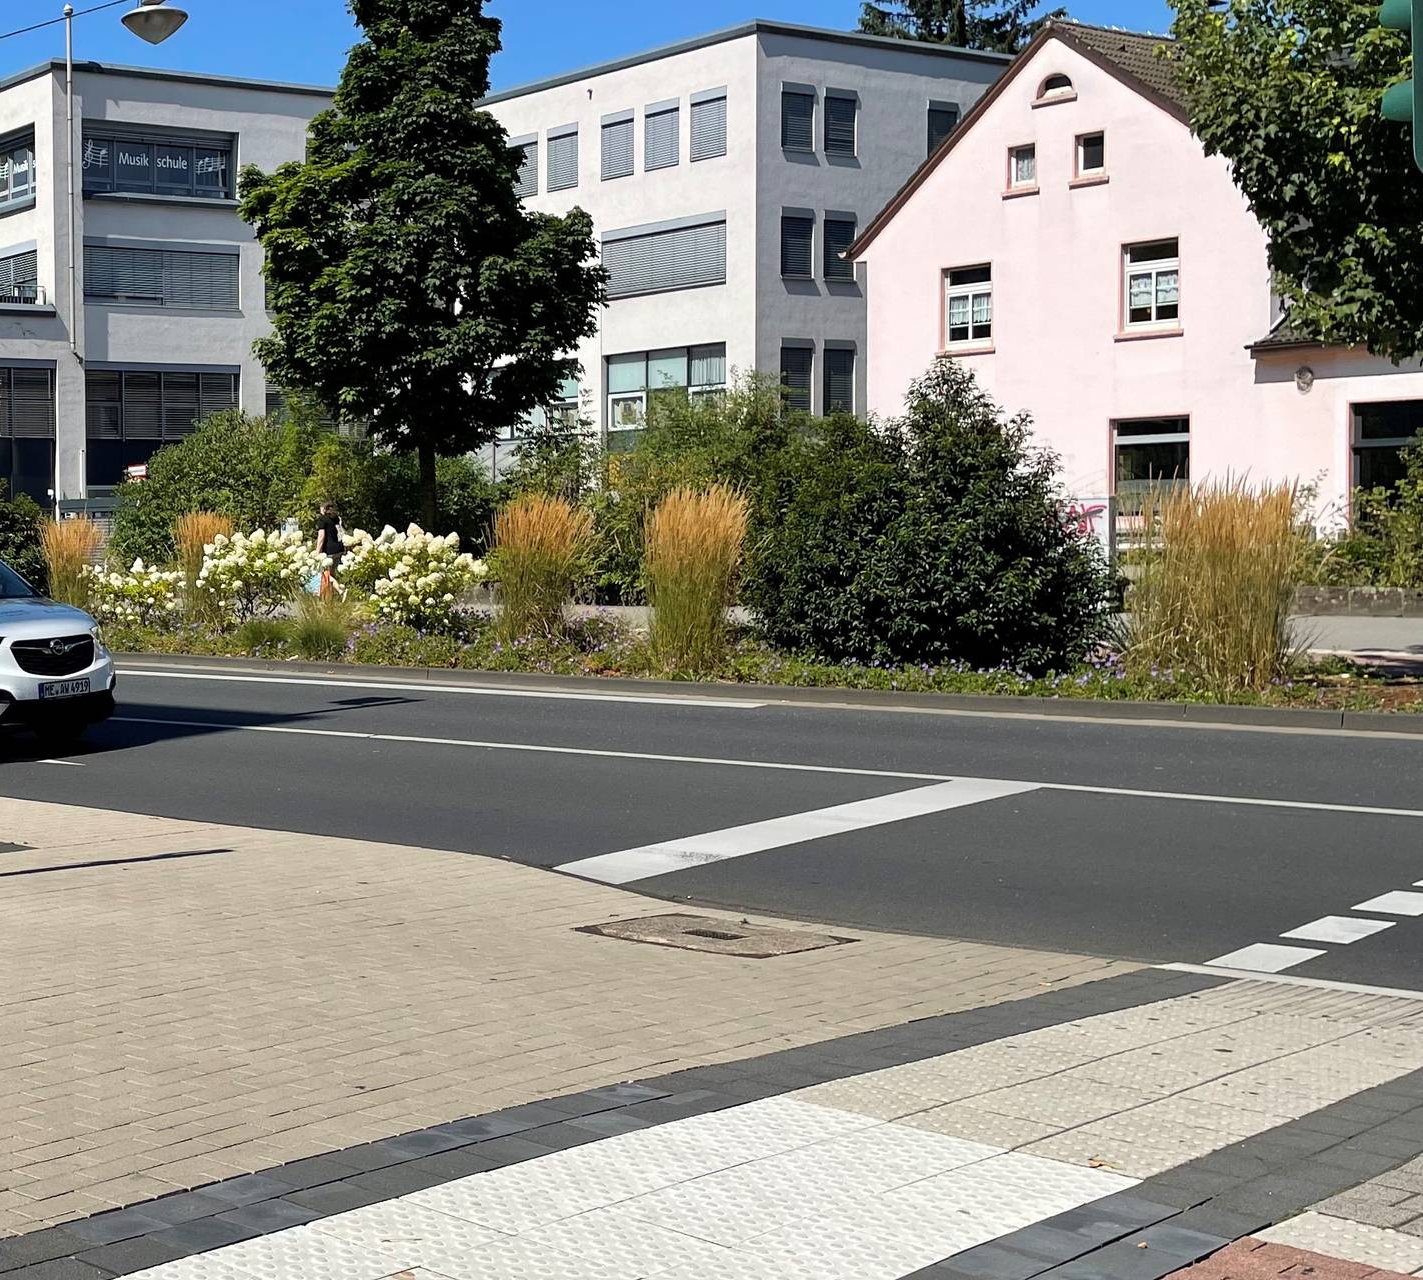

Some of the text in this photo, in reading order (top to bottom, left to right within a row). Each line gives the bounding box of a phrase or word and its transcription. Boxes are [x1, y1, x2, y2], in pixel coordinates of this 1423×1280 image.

[118, 152, 188, 170] Musik schule
[71, 680, 89, 694] 4919
